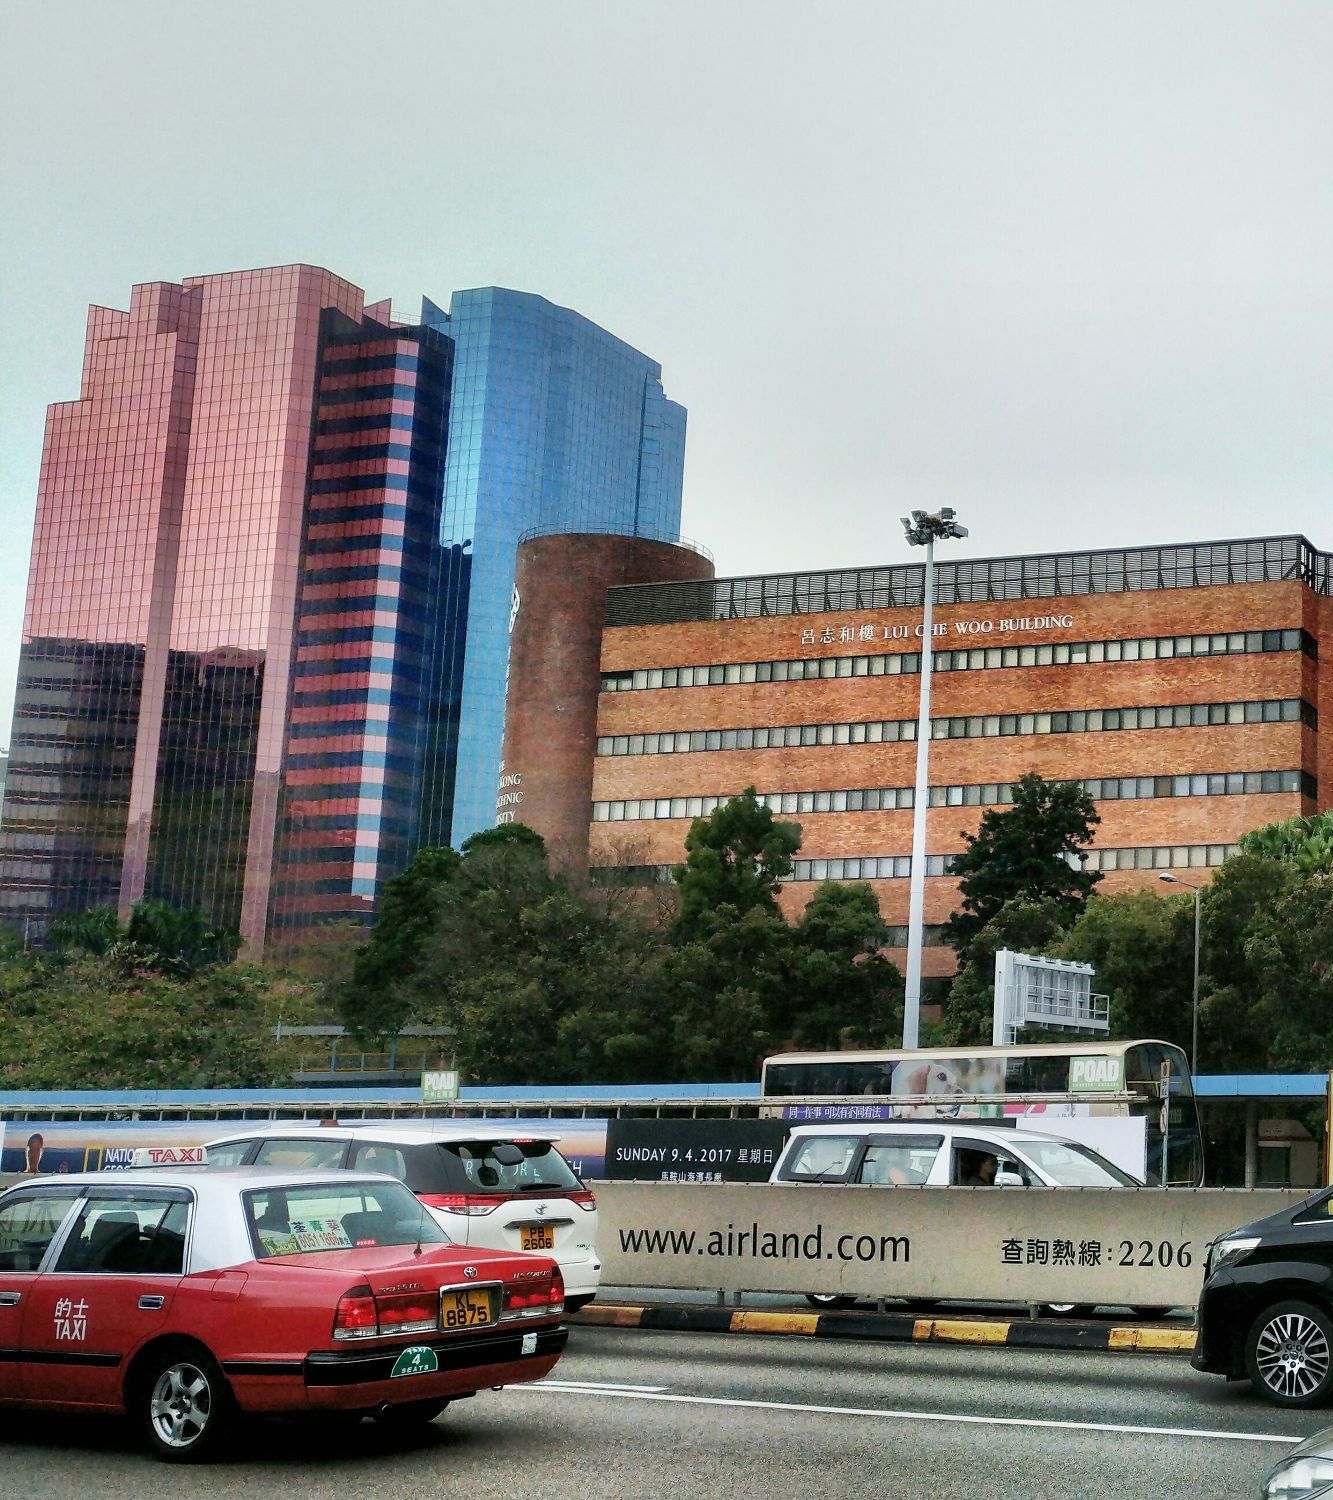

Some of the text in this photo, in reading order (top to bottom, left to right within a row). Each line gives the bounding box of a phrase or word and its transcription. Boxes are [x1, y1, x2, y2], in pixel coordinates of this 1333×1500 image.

[800, 625, 875, 646] 呂志和樓
[883, 626, 909, 640] LUI
[954, 620, 993, 635] WOO
[999, 615, 1074, 632] BUILDING
[1072, 1060, 1120, 1083] POAD
[424, 1073, 455, 1091] POAD
[105, 1148, 134, 1163] NATIO
[148, 1149, 203, 1163] TAXI
[616, 1147, 774, 1164] SUNDAY 9.4.2017 星期日
[529, 1227, 545, 1238] PB
[523, 1238, 553, 1251] 2606
[618, 1222, 911, 1263] www.airland.com
[55, 1297, 89, 1319] 的士
[455, 1293, 475, 1311] KL
[446, 1305, 488, 1327] 8875
[54, 1318, 88, 1341] TAXI
[411, 1353, 421, 1366] 4
[401, 1364, 429, 1374] SEATS
